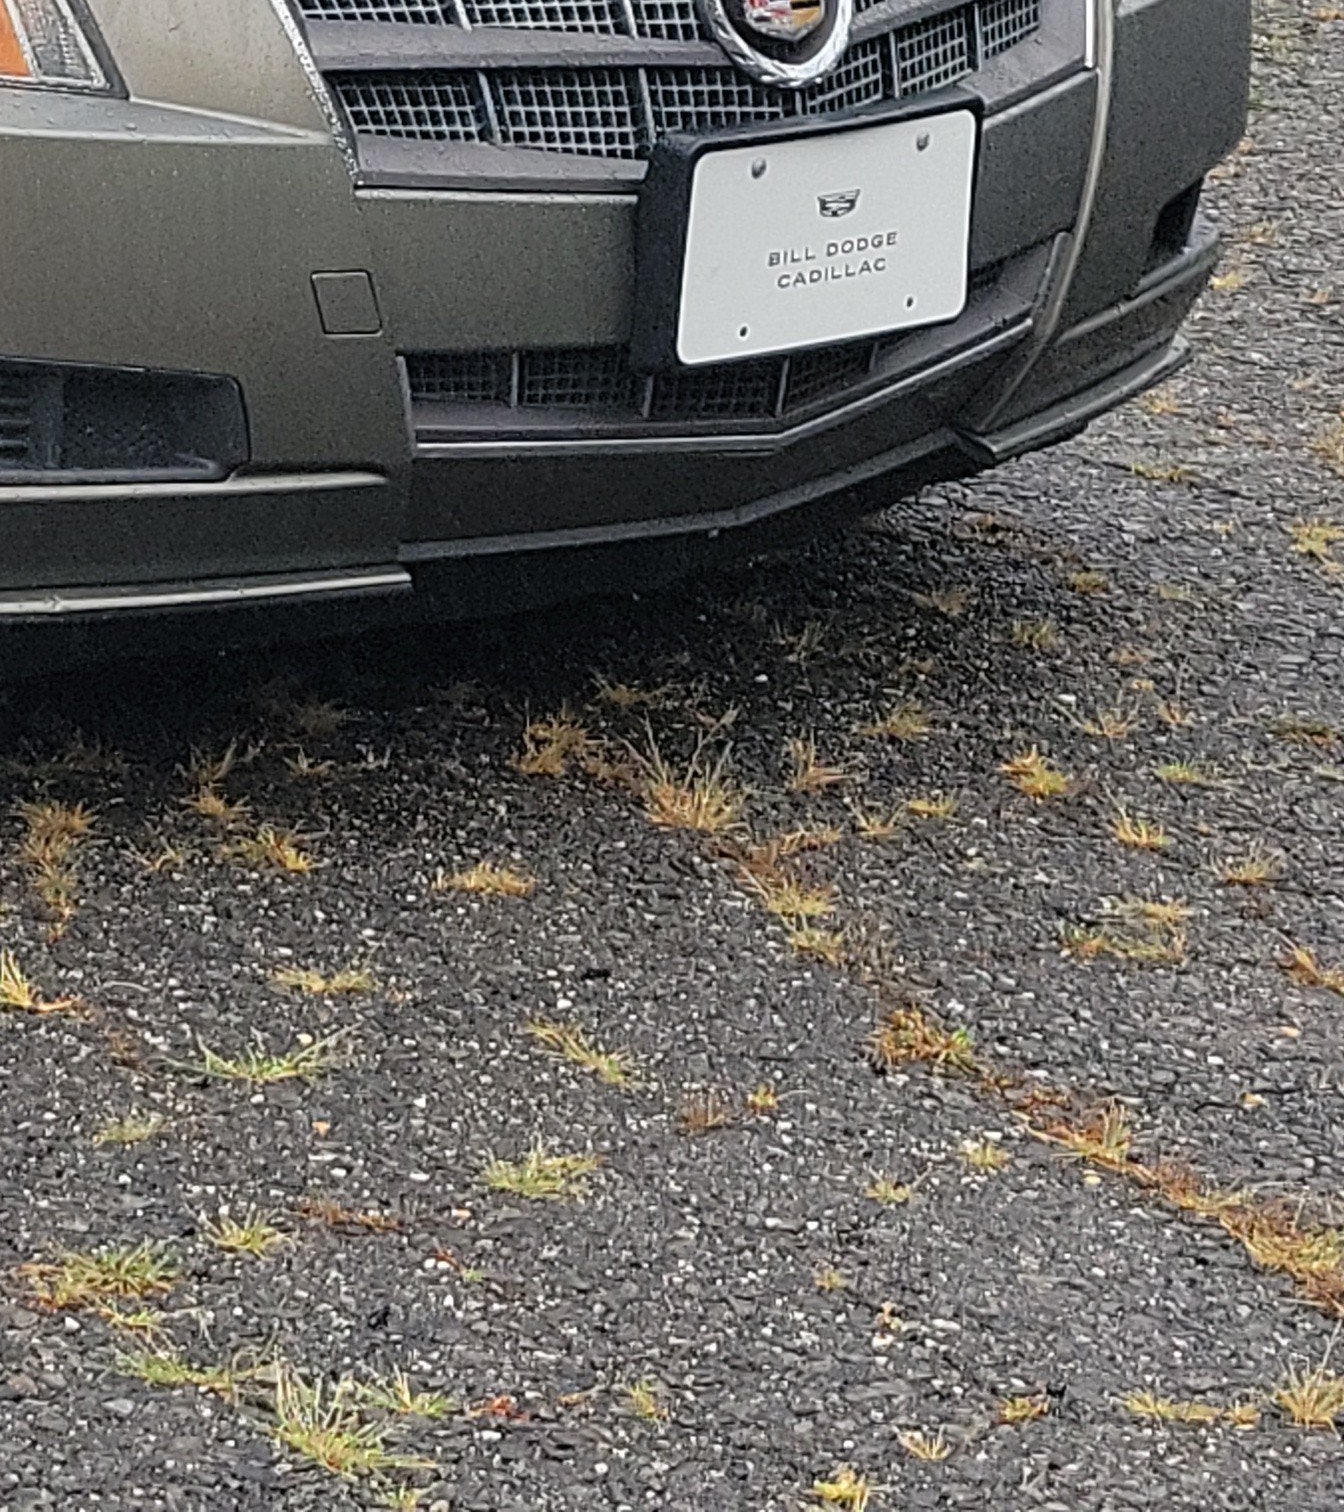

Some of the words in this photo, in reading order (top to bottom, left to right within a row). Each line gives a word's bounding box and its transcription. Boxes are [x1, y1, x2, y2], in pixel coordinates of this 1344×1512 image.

[768, 247, 816, 267] BILL
[826, 232, 898, 257] DODGE
[777, 257, 887, 288] CADILLAC
